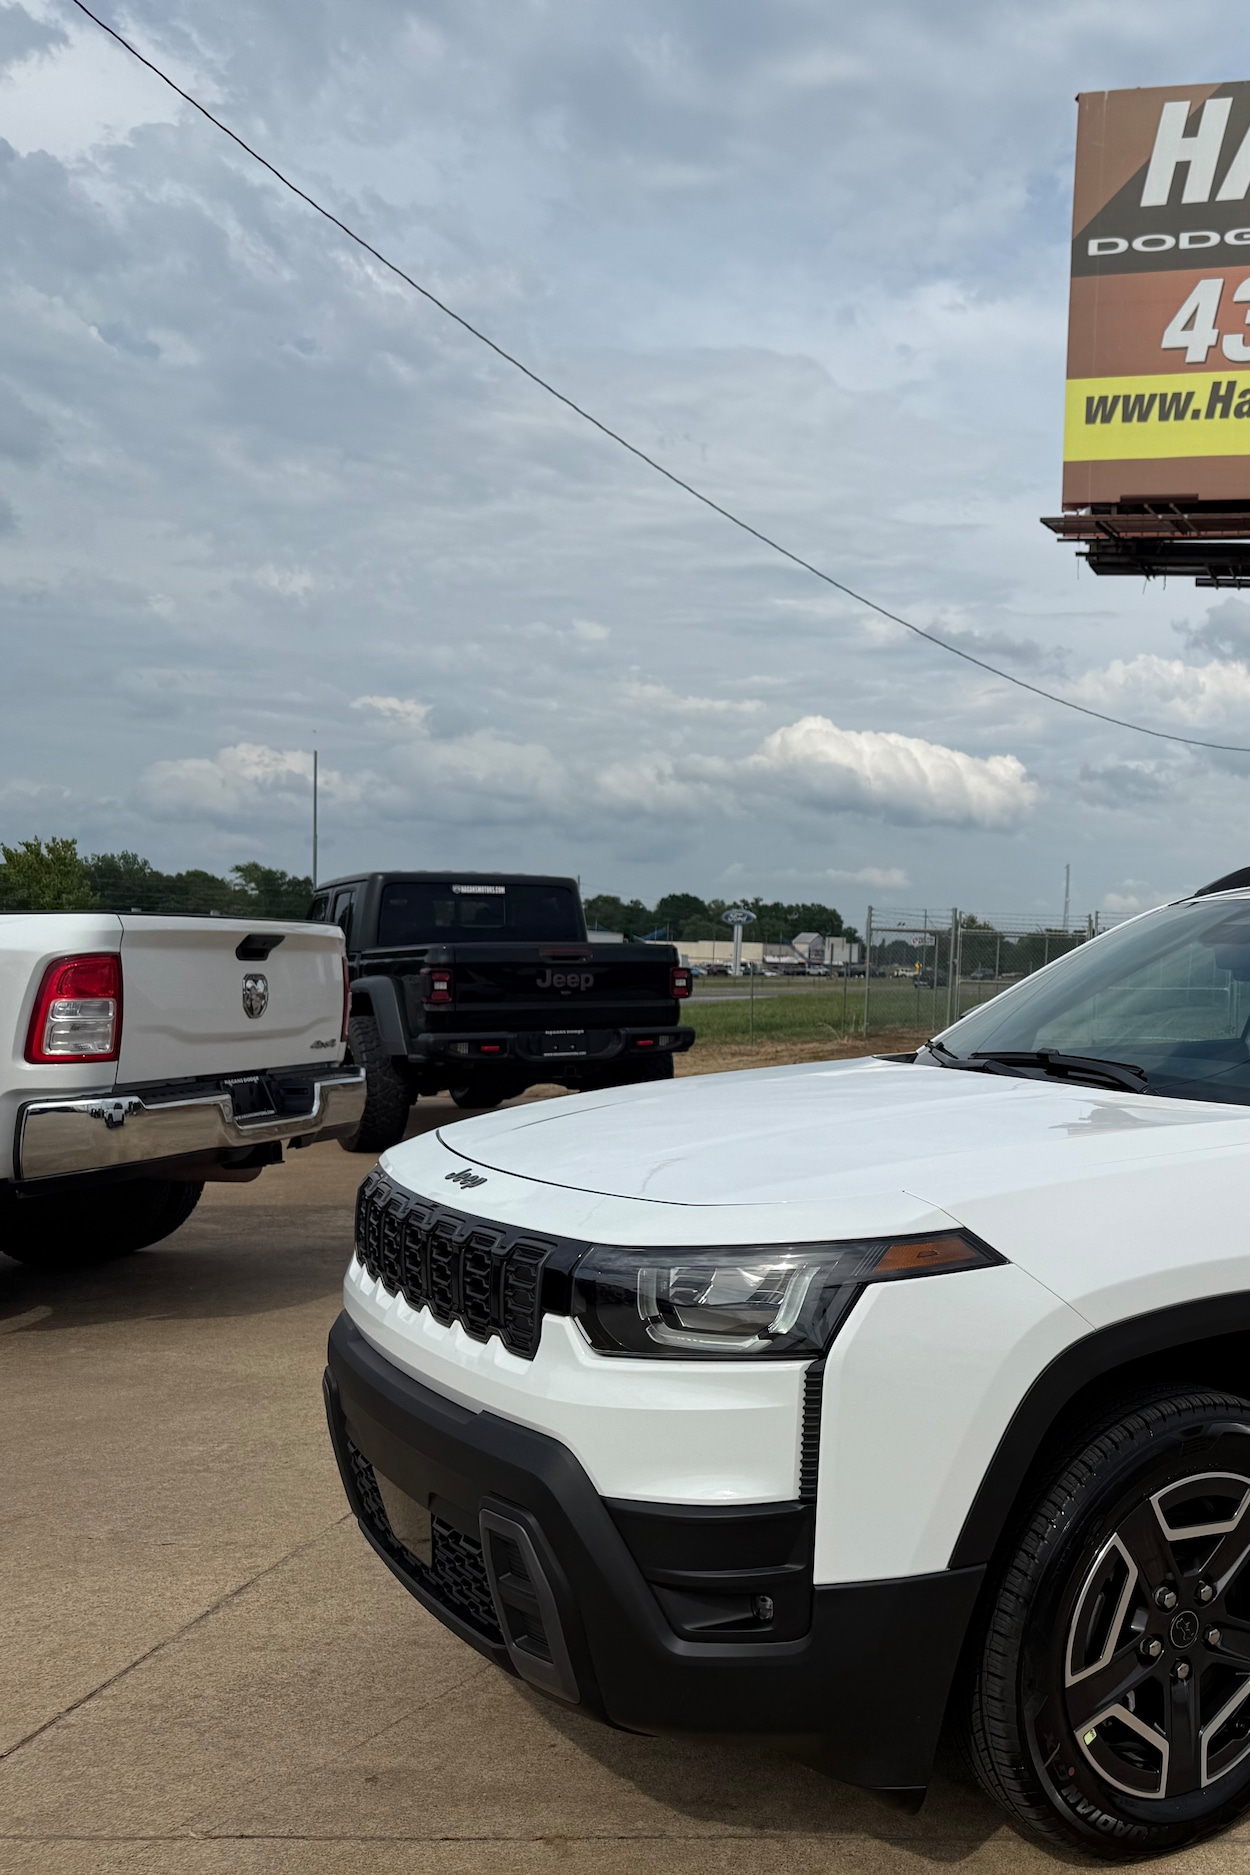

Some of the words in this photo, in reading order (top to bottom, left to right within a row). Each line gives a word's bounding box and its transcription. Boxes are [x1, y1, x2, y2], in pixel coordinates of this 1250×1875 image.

[536, 968, 595, 991] Jeep
[445, 1168, 488, 1190] Jeep
[1060, 1782, 1167, 1841] OADIAN
